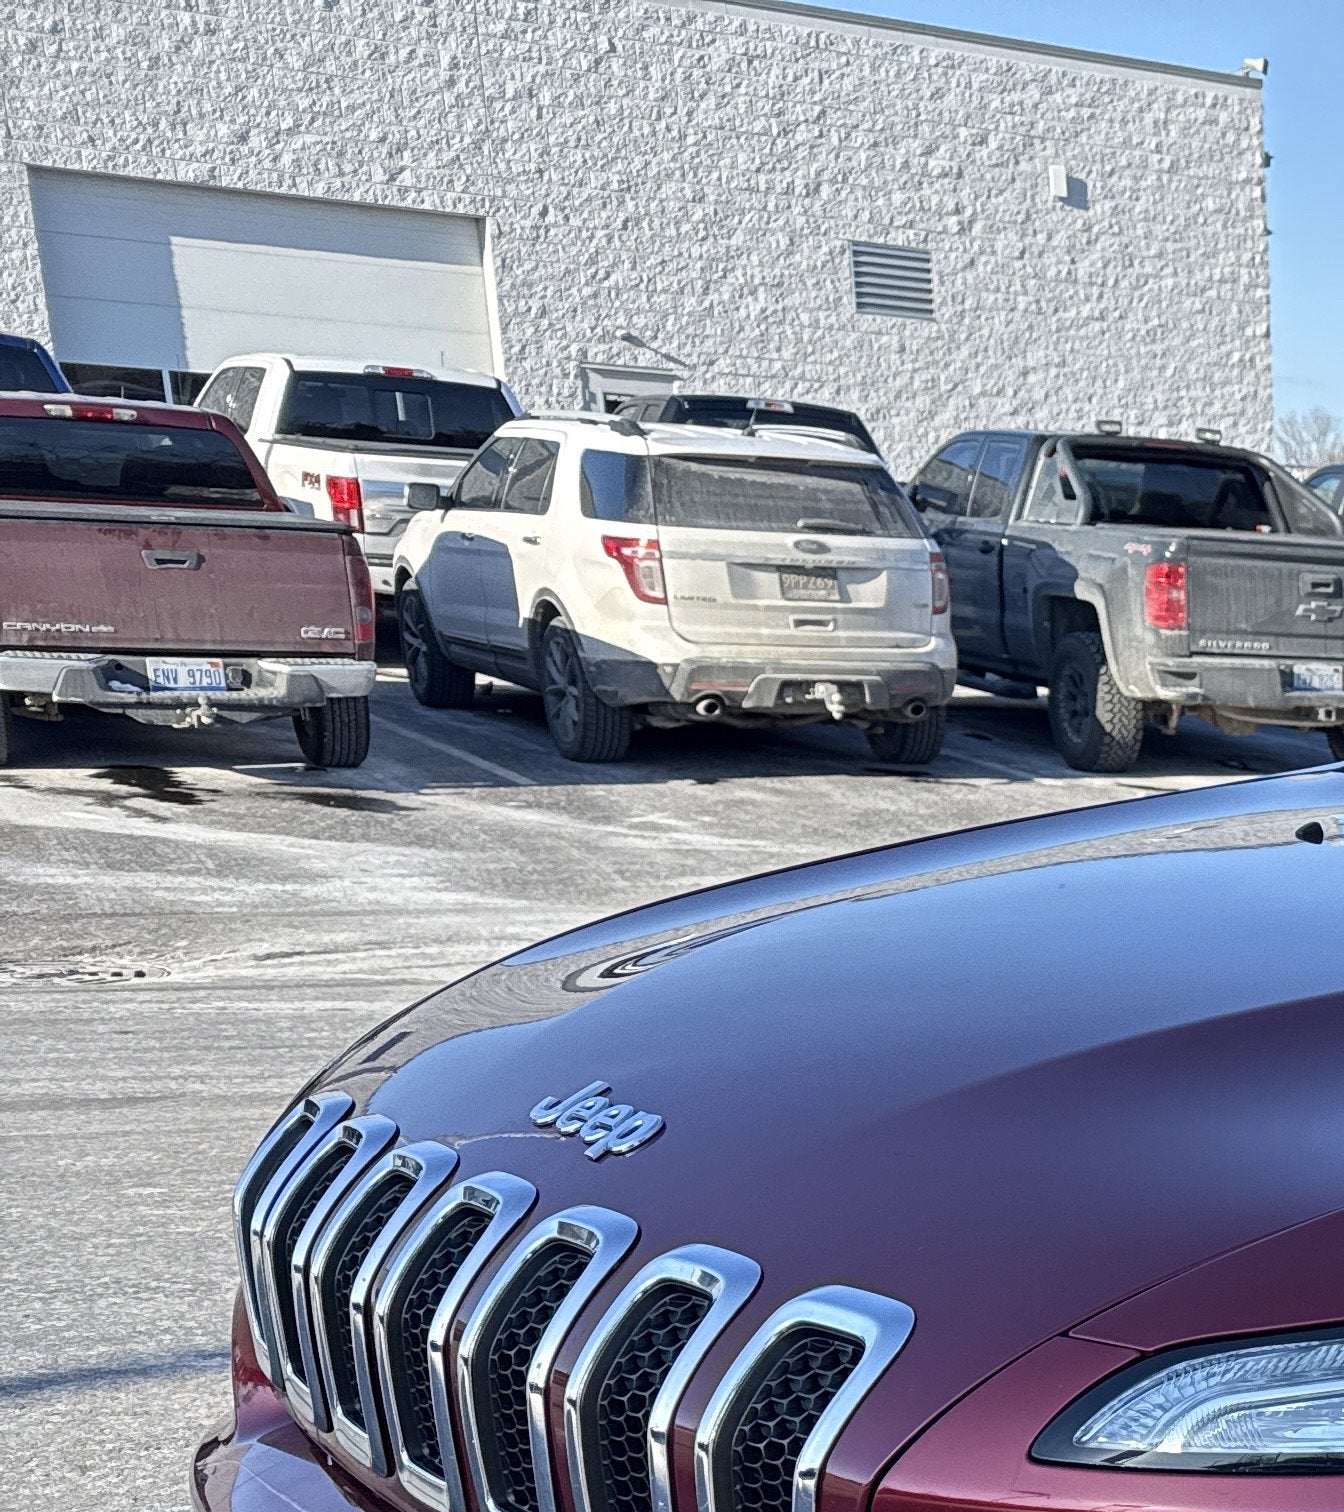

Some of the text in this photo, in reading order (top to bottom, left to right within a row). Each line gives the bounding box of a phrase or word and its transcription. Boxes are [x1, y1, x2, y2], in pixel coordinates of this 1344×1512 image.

[2, 621, 90, 632] CANYON
[300, 626, 346, 639] GMC
[187, 668, 221, 686] 9790
[529, 1080, 665, 1162] Jeep
